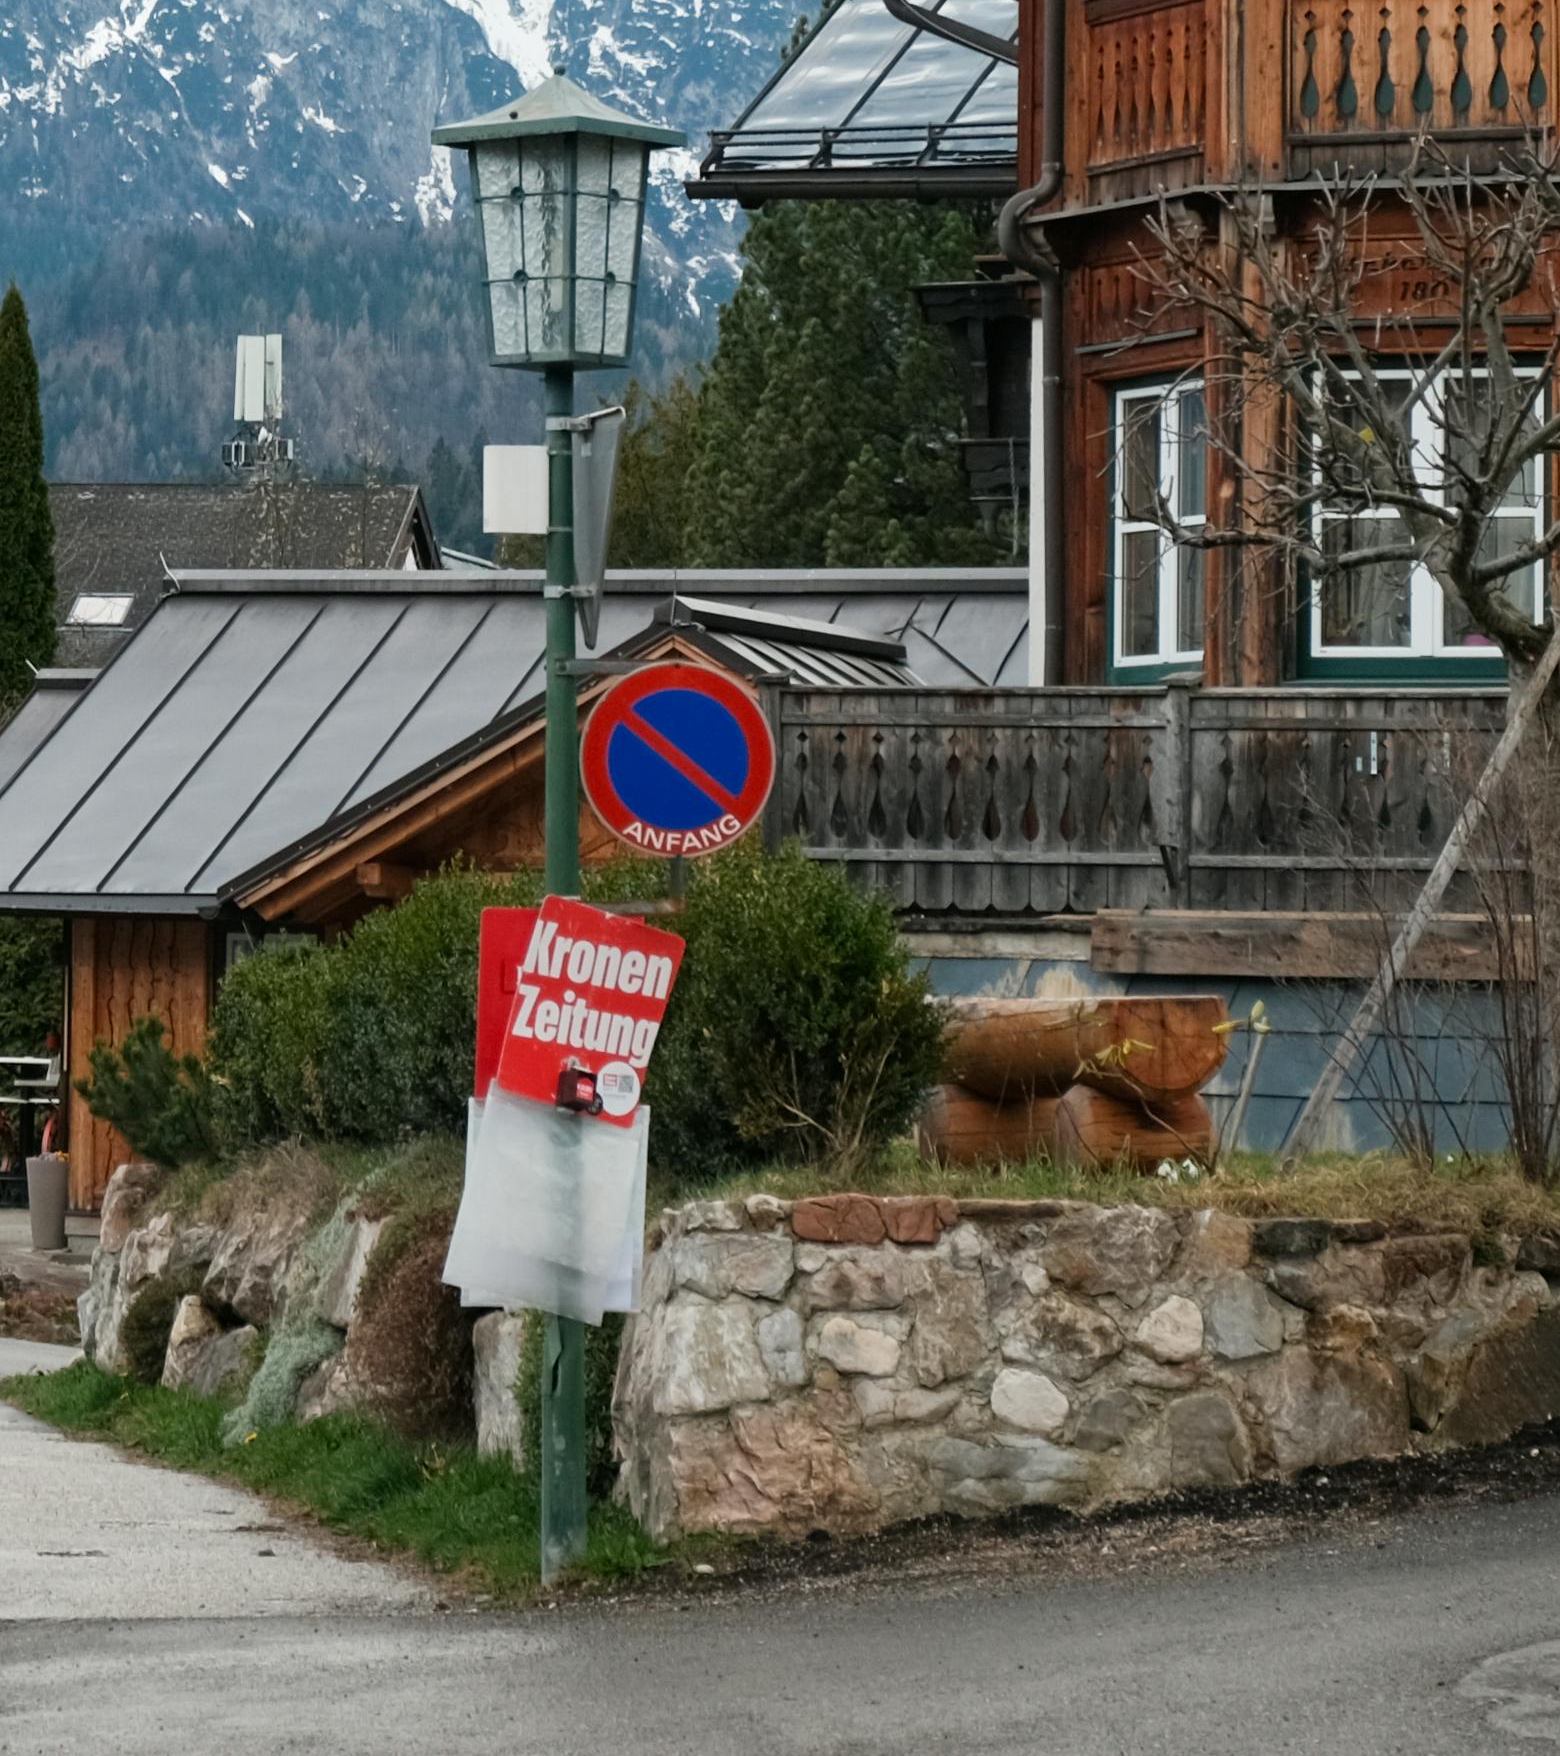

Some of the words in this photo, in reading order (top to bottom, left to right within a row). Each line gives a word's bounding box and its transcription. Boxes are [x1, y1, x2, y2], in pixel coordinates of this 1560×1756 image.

[622, 813, 742, 852] ANFANG
[523, 919, 673, 1001] Kronen
[511, 983, 662, 1069] Zeitung
